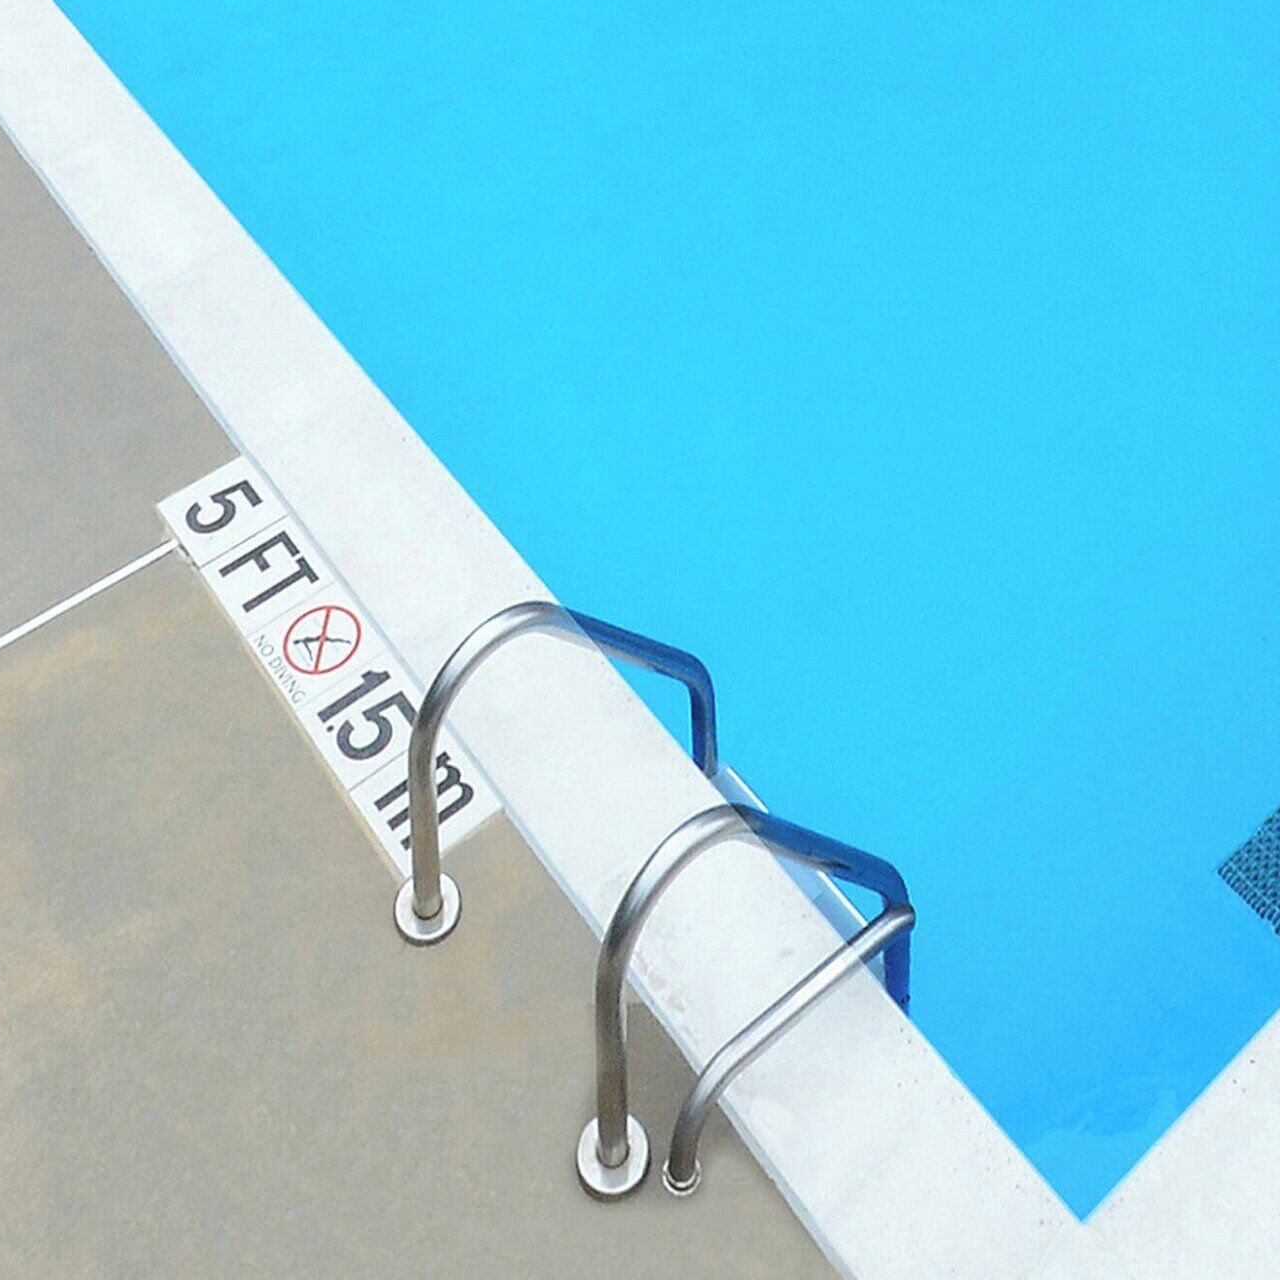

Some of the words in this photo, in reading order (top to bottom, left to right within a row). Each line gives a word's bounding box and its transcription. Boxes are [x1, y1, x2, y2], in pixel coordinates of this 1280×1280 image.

[184, 479, 264, 534] 5
[218, 530, 319, 613] FT
[253, 634, 274, 656] NO
[317, 669, 418, 761] 1.5
[373, 751, 475, 852] m
